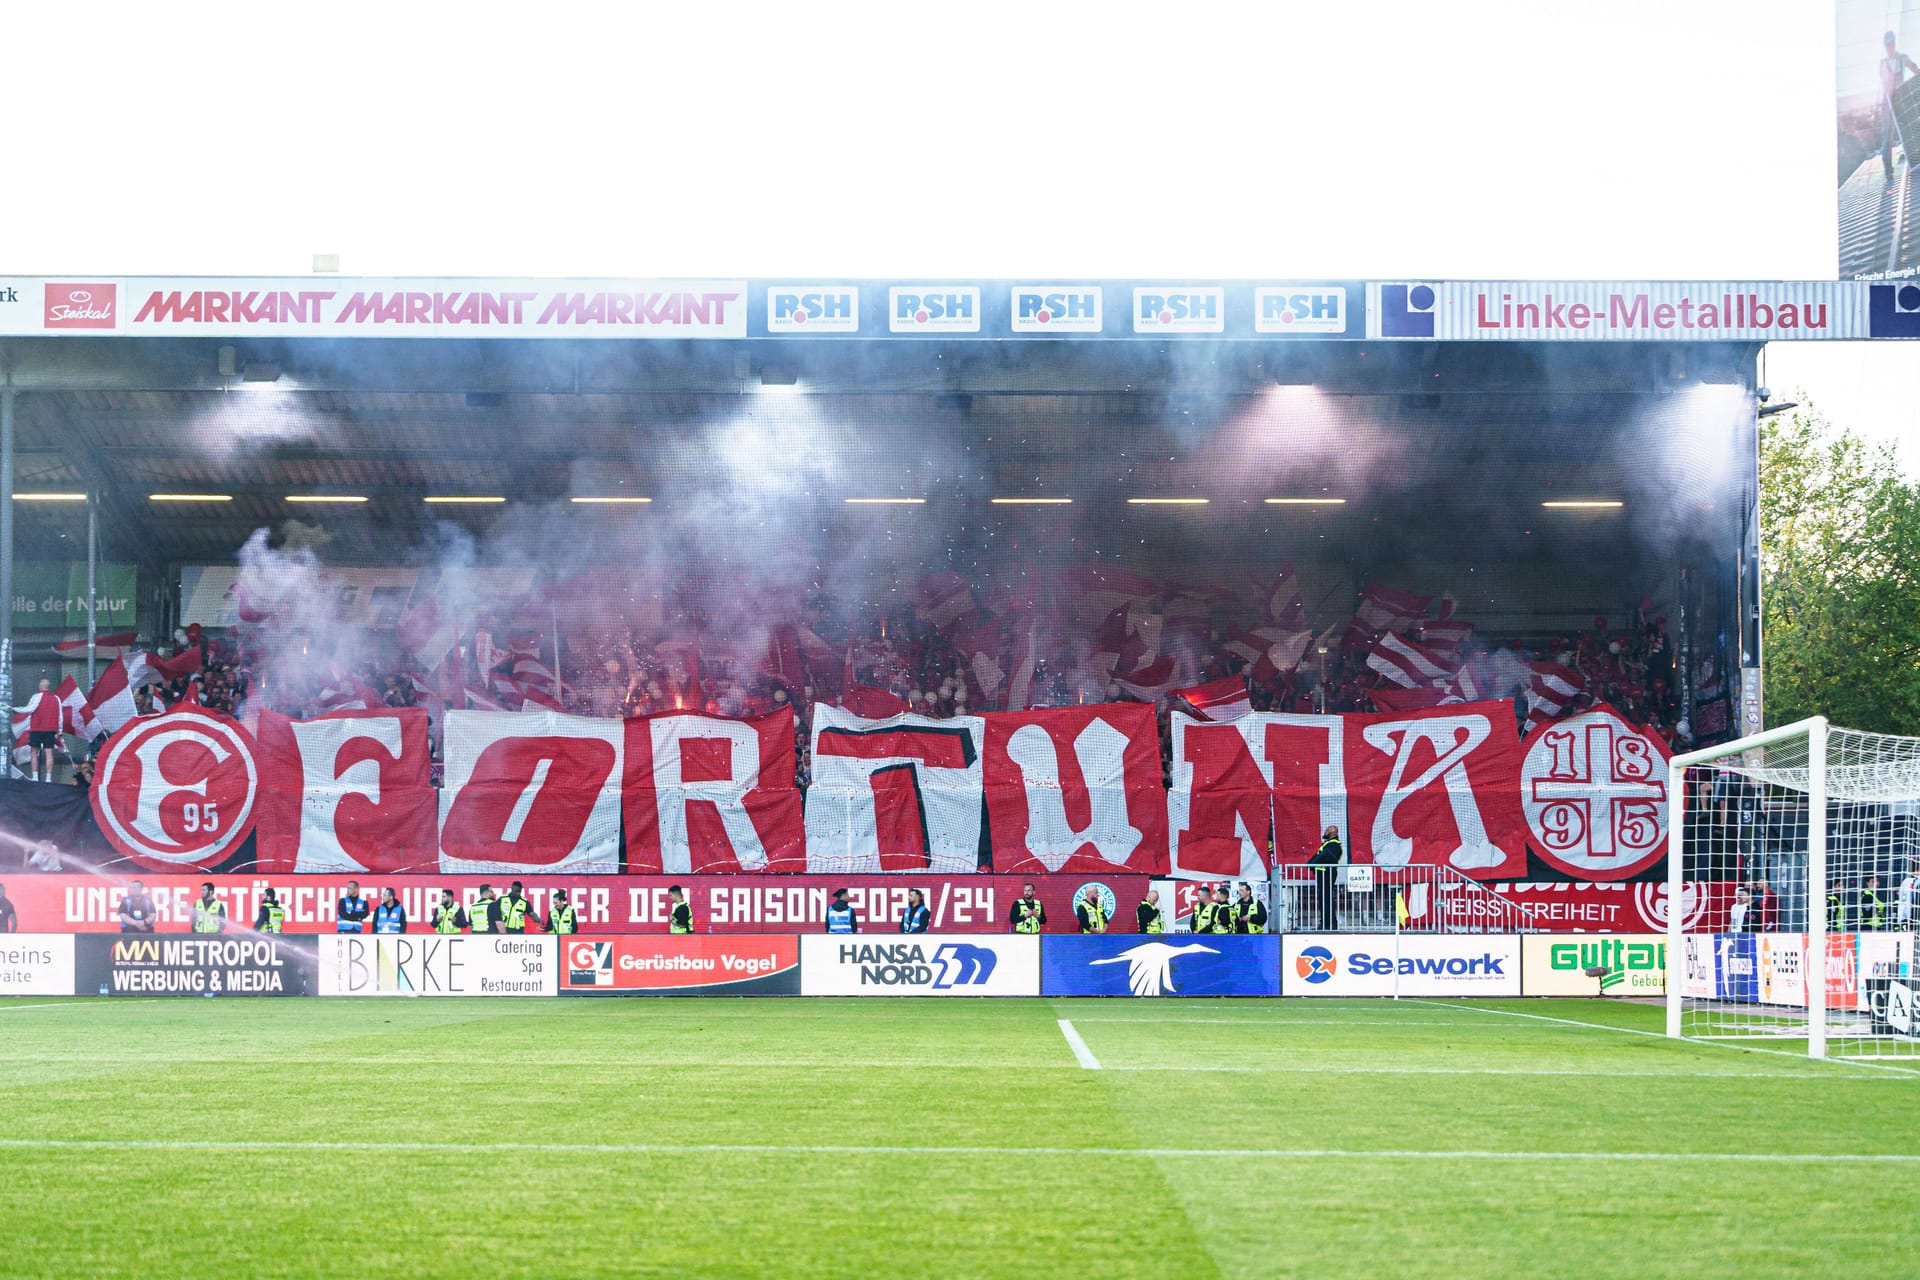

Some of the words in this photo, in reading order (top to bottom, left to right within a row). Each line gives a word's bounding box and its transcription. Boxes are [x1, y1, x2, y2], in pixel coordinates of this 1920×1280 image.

[1885, 267, 1916, 279] Energie
[49, 302, 112, 321] Steiskal
[133, 291, 336, 323] MARKANT
[335, 292, 538, 324] MARKANT
[536, 293, 739, 325] MARKANT
[775, 294, 850, 318] RSH
[897, 294, 972, 318] RSH
[1019, 294, 1094, 318] RSH
[1141, 295, 1216, 319] RSH
[1263, 295, 1338, 319] RSH
[1478, 294, 1827, 329] Linke-Metallbau
[42, 596, 72, 612] der
[184, 802, 219, 832] 95
[710, 887, 828, 923] SAISON
[1521, 902, 1621, 922] FREIHEIT
[163, 941, 283, 966] METROPOL
[495, 939, 542, 957] Catering
[840, 944, 927, 964] HANSA
[349, 938, 465, 992] BIRKE
[522, 959, 542, 976] Spa
[619, 952, 715, 971] Gerüstbau
[720, 953, 776, 975] Vogel
[1348, 953, 1504, 975] Seawork
[114, 970, 209, 992] WERBUNG
[210, 970, 222, 992] &
[233, 970, 282, 992] MEDIA
[481, 977, 542, 993] Restaurant
[861, 966, 932, 985] NORD
